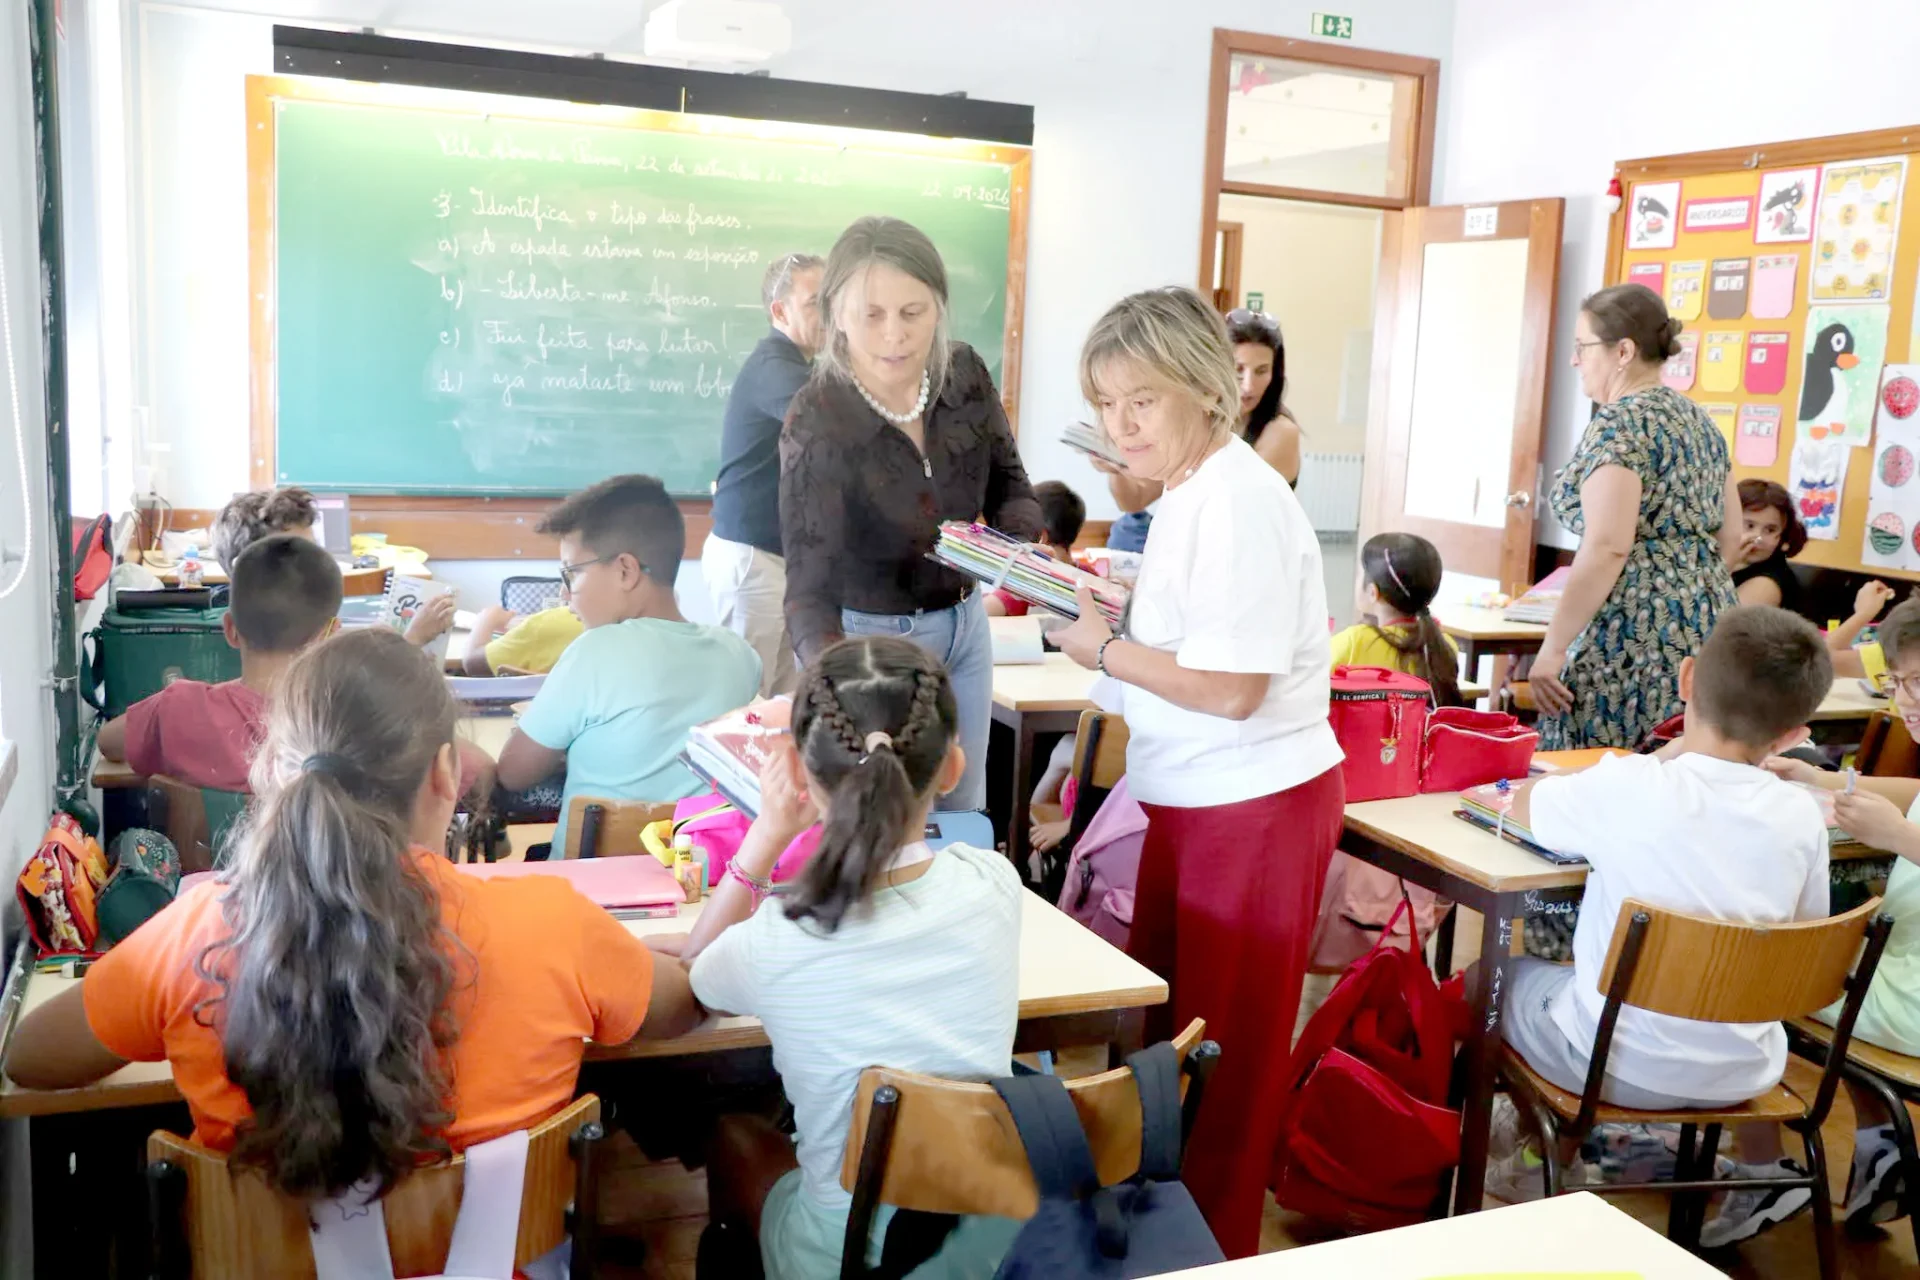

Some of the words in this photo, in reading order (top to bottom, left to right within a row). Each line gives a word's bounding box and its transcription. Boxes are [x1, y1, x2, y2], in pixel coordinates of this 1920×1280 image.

[635, 155, 660, 172] 22
[668, 154, 685, 174] de
[469, 186, 576, 232] Identifica
[610, 200, 647, 236] tipo
[656, 207, 681, 226] das
[510, 237, 573, 266] espada
[582, 234, 644, 259] estava
[652, 247, 676, 261] em
[441, 275, 464, 311] b)
[482, 319, 527, 344] Fui
[537, 322, 593, 359] feita
[606, 332, 649, 362] para
[540, 363, 633, 393] mataste
[649, 379, 684, 393] um
